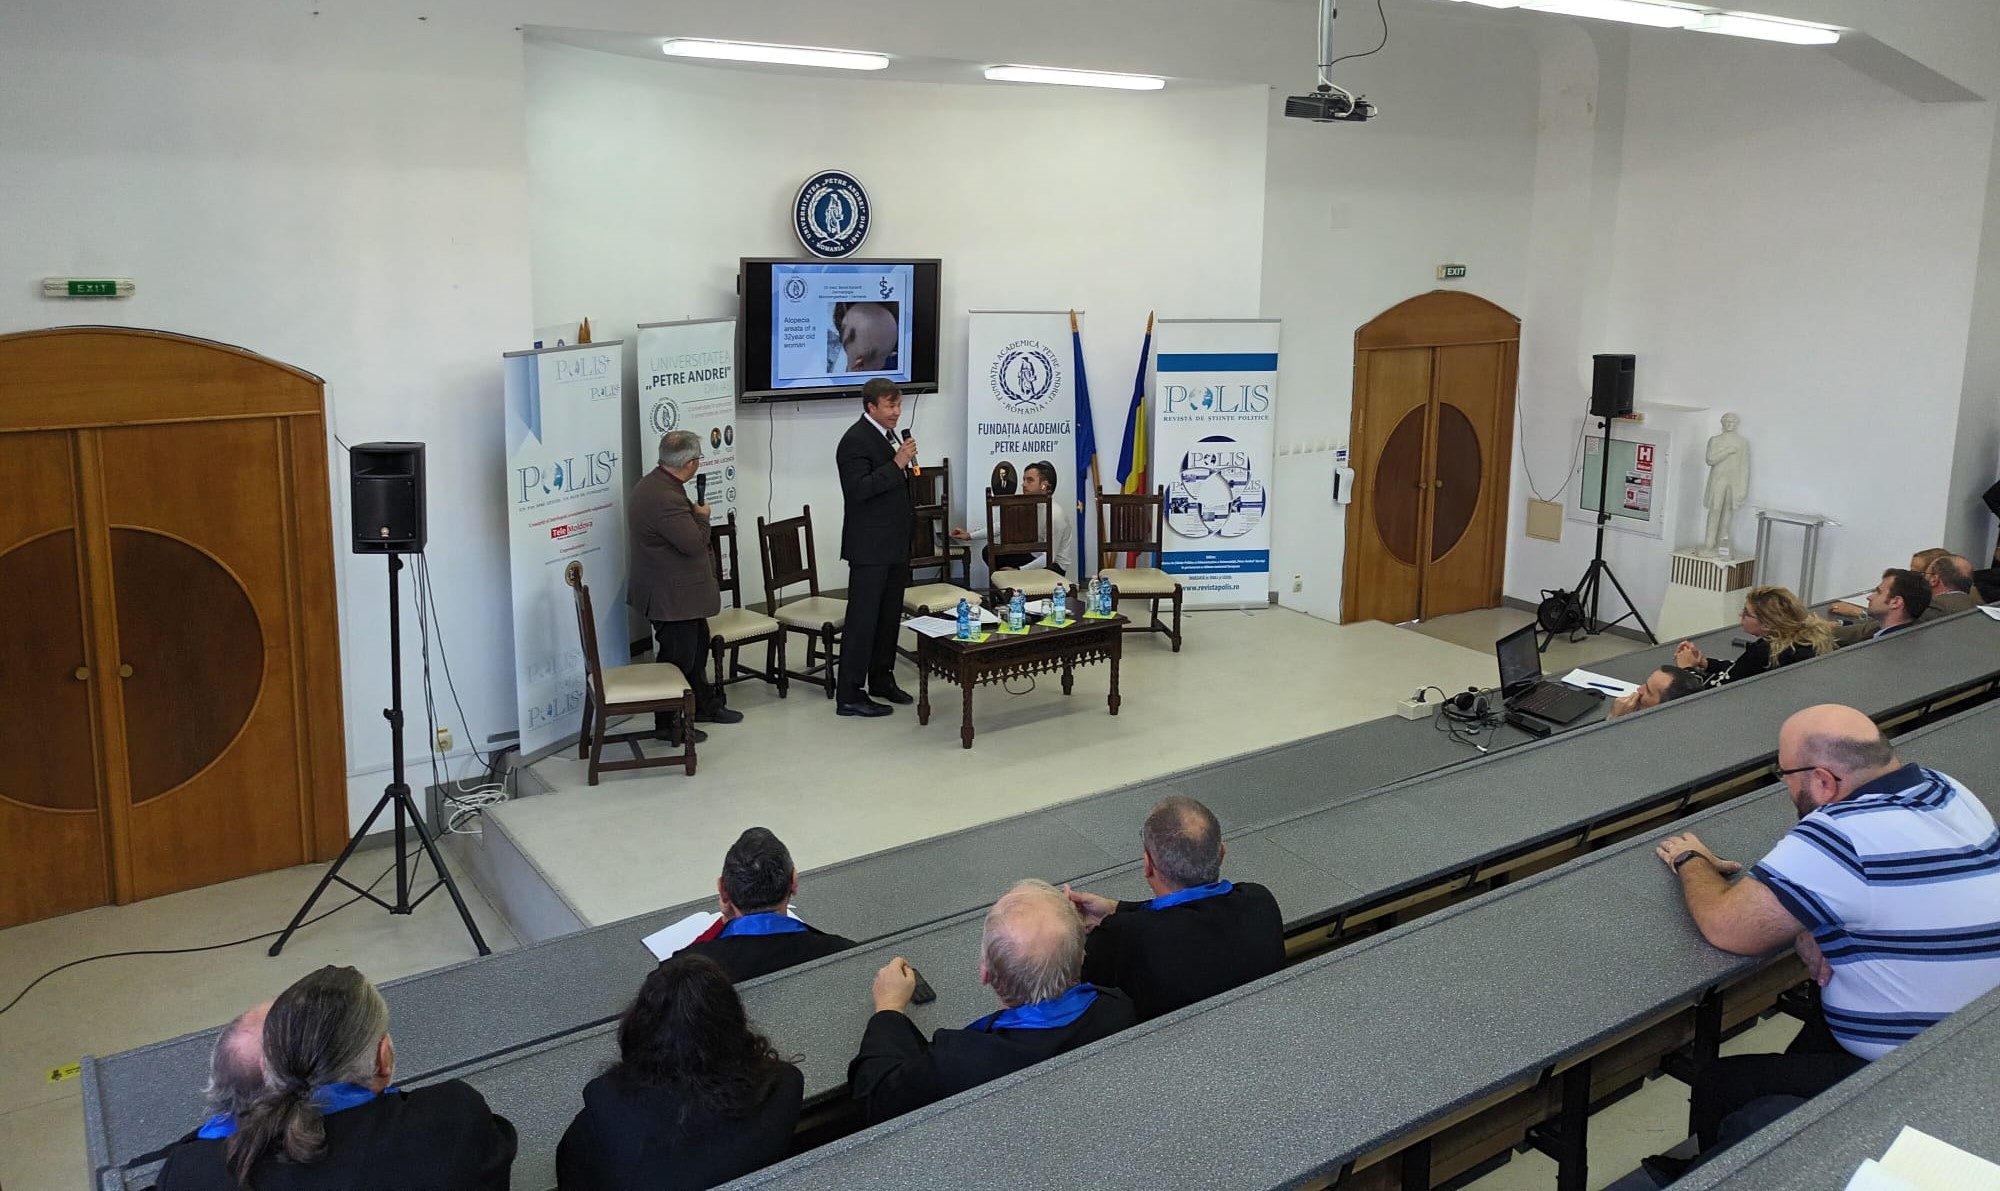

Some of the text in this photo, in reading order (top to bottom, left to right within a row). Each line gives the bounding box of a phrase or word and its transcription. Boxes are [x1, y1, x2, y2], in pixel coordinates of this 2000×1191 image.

[1447, 267, 1465, 276] EXIT
[76, 284, 108, 293] EXIT
[650, 351, 730, 371] UNIVERSITATEA
[646, 372, 686, 390] „PETRE
[1163, 384, 1268, 413] POLIS
[1022, 419, 1071, 435] ACADEMICĂ
[1639, 447, 1651, 461] H
